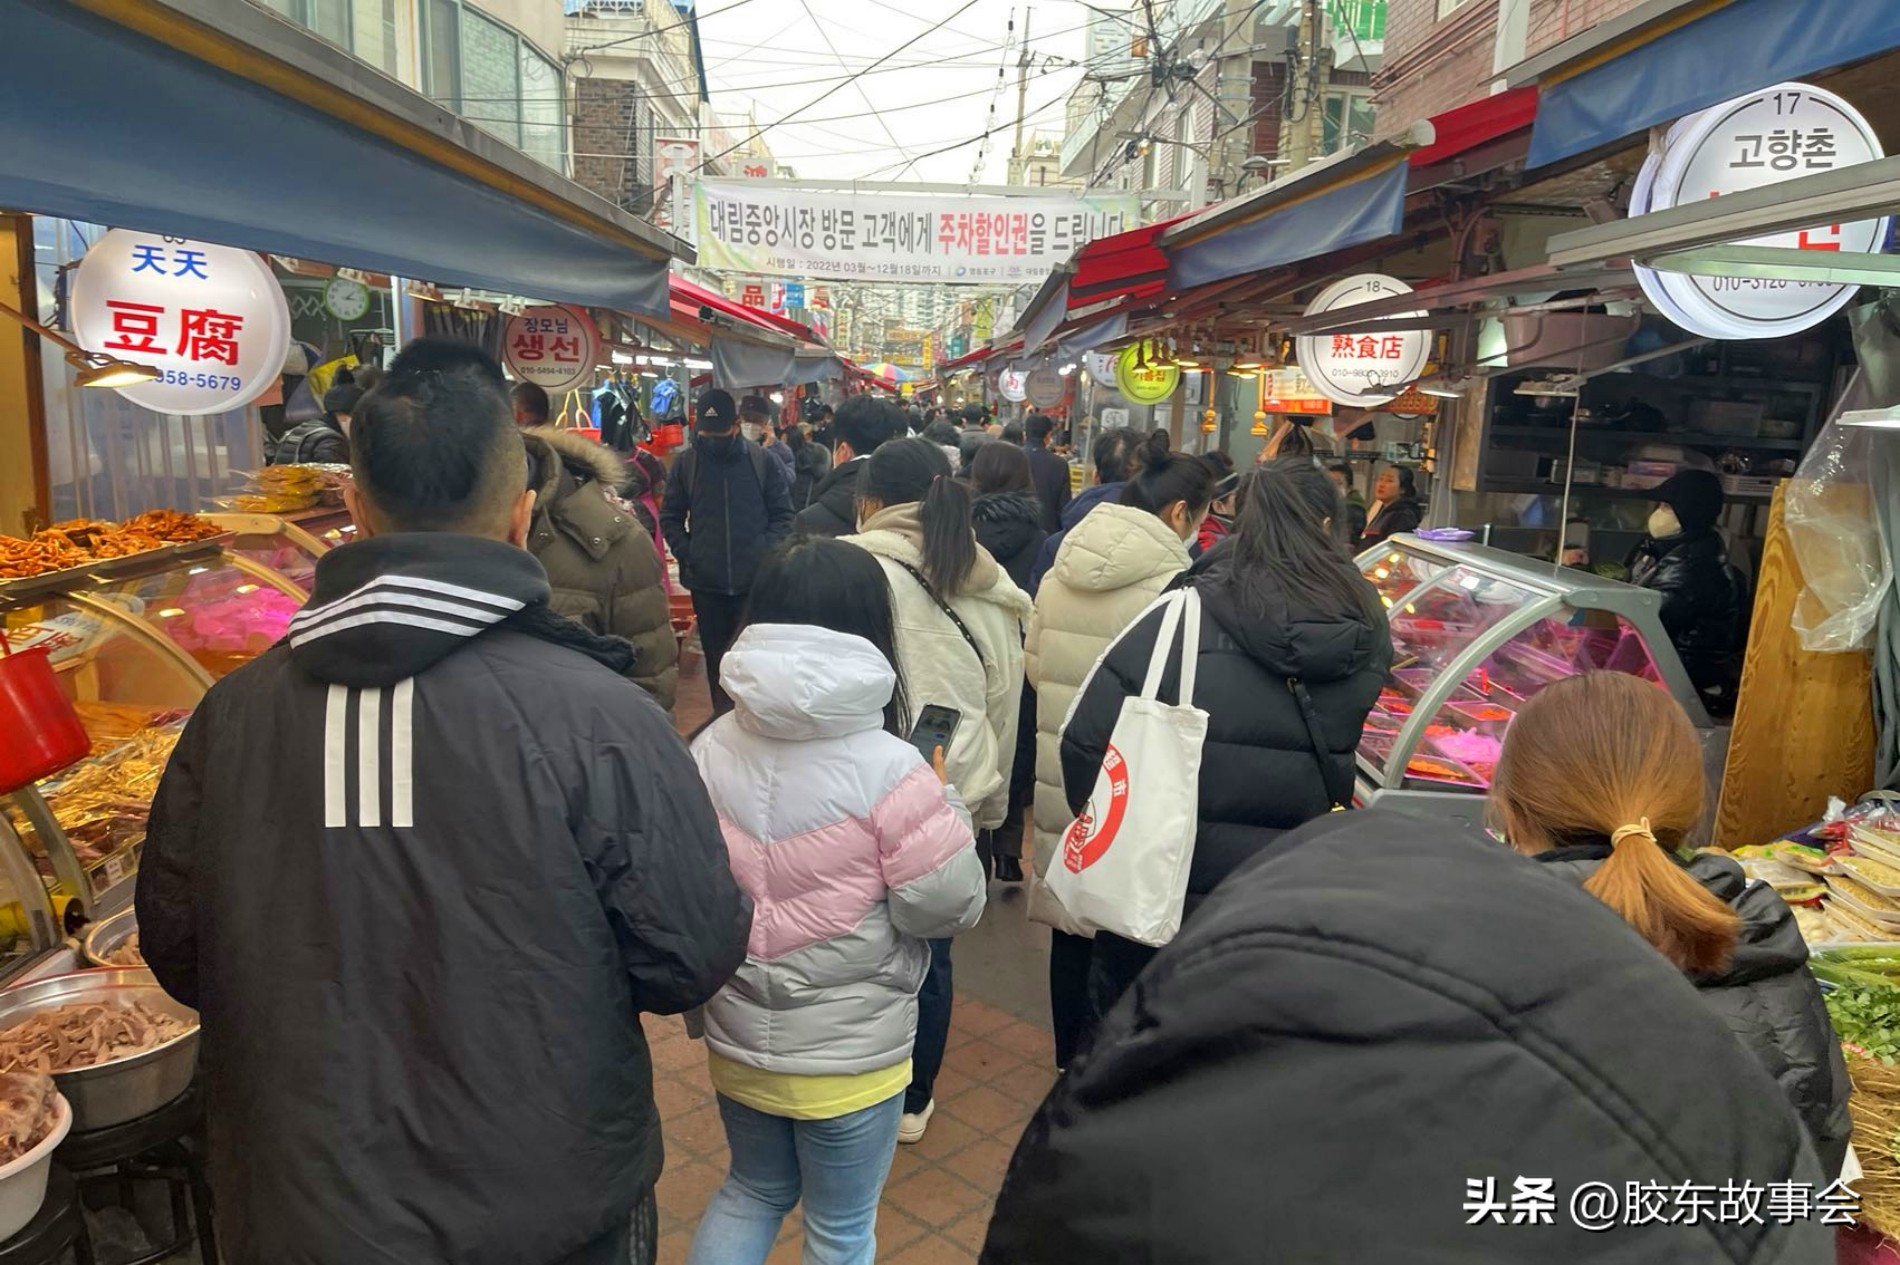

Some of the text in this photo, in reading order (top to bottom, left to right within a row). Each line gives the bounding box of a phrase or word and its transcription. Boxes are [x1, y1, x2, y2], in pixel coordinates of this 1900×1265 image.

[1773, 92, 1801, 115] 17
[1729, 128, 1837, 171] 고향촌
[709, 200, 816, 250] 대림중앙시장
[821, 207, 856, 251] 방문
[861, 210, 932, 254] 고객에게
[938, 212, 1047, 255] 주차할인권을
[132, 244, 208, 280] 天天
[766, 256, 796, 270] 시행일
[806, 259, 841, 273] 2022년
[1365, 280, 1381, 293] 18
[103, 300, 243, 366] 豆腐
[524, 317, 568, 334] 장모님
[513, 334, 579, 362] 생선
[1331, 332, 1404, 360] 熟食店
